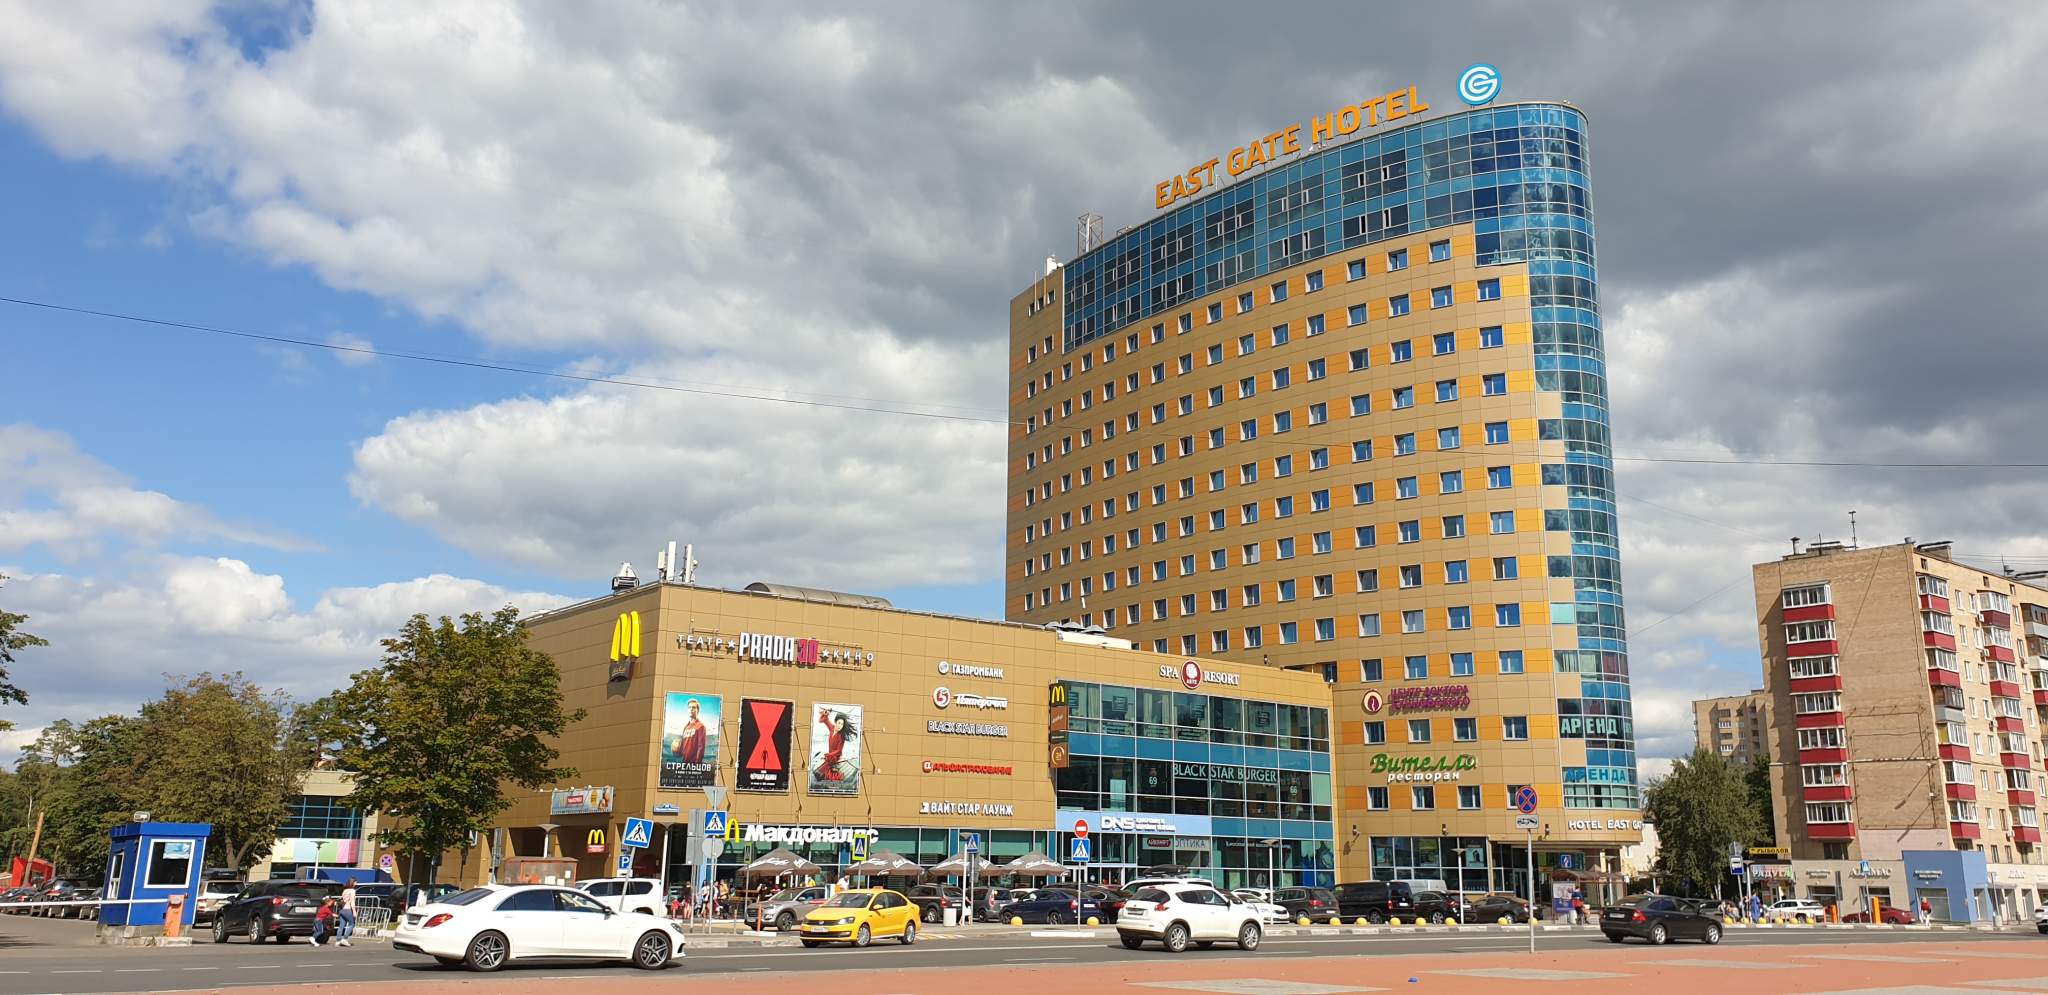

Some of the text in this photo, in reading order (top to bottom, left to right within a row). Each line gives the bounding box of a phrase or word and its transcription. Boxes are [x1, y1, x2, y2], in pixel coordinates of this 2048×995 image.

[1155, 85, 1429, 209] EAST GATE HOTEL
[677, 634, 723, 647] ТЕАТР
[738, 631, 795, 662] PRADA
[832, 649, 874, 662] КИНО
[952, 663, 1004, 679] ГАЗПРОМБАНК
[1159, 665, 1240, 686] SPA RESORT
[927, 720, 1008, 737] BLACK STAR BURGER
[666, 762, 712, 772] СТРЕЛЬЦОВ
[1370, 752, 1477, 773] Вителло
[1174, 763, 1277, 782] BLACK STAR BURGER
[1388, 771, 1460, 783] ресторан
[1567, 768, 1626, 783] АРЕНДА
[1148, 776, 1158, 786] 69
[930, 800, 1014, 817] ВАЙТ СТАР ЛАУНЖ
[1101, 816, 1136, 831] DNS
[1569, 820, 1604, 831] HOTEL
[1607, 820, 1630, 831] EAST
[1175, 838, 1206, 849] ОПТИКА
